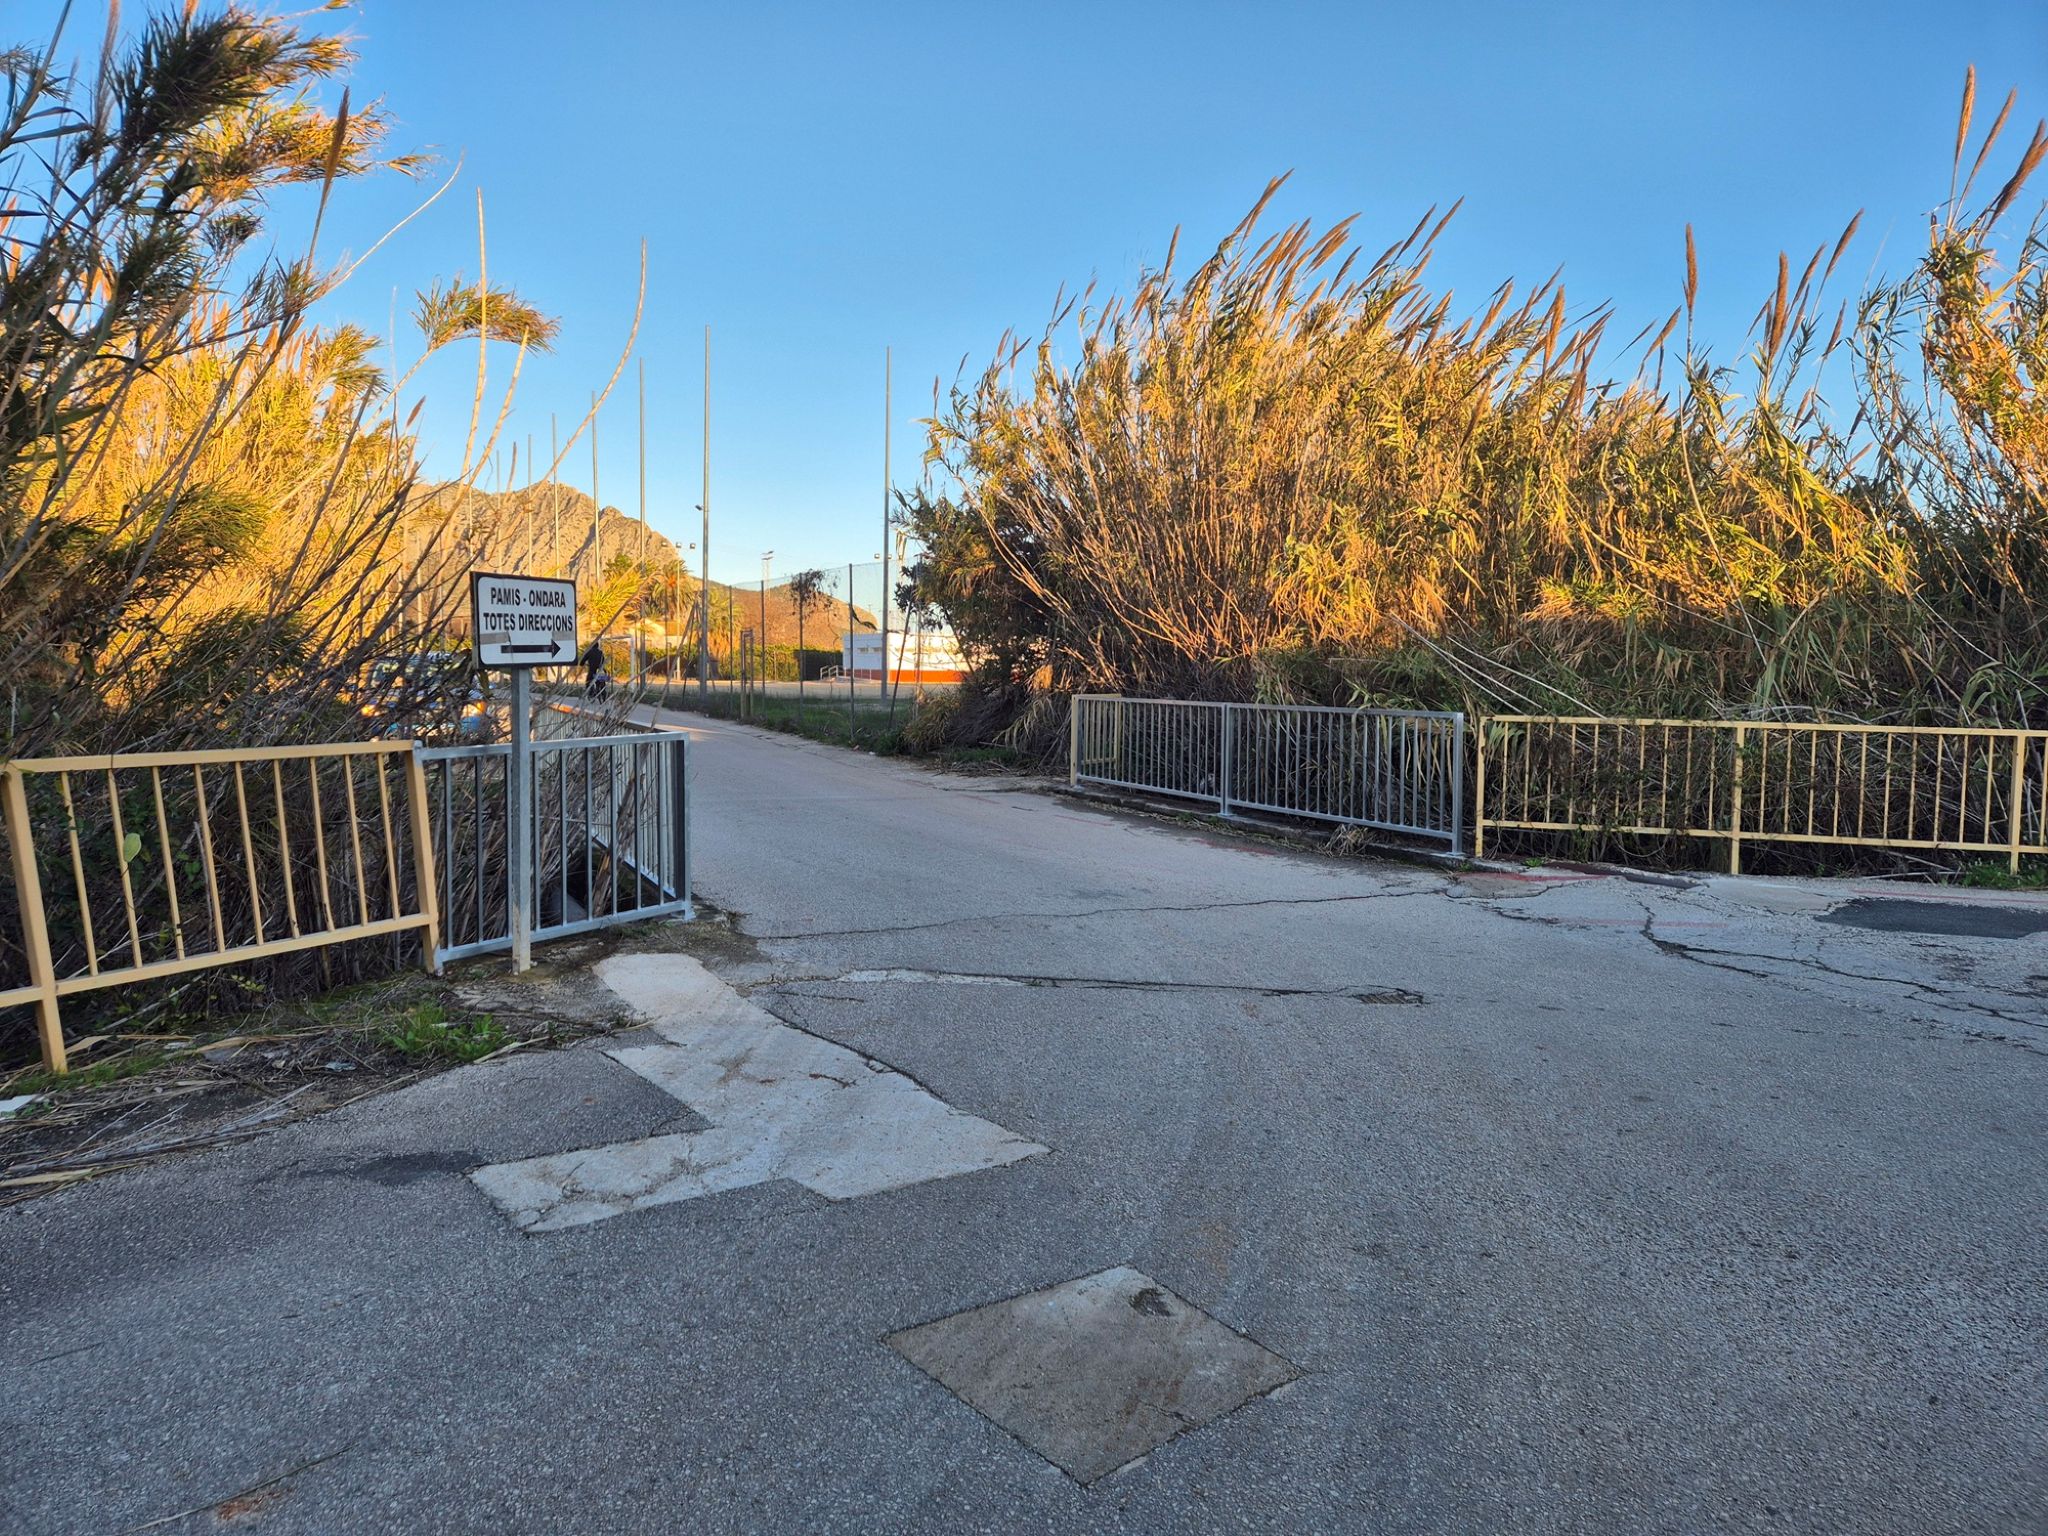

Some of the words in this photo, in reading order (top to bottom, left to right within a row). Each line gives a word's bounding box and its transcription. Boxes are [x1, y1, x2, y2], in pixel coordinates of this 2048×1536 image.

[491, 587, 520, 606] PAMIS
[529, 590, 566, 608] ONDARA
[483, 612, 516, 631] TOTES
[519, 614, 573, 632] DIRECCIONS
